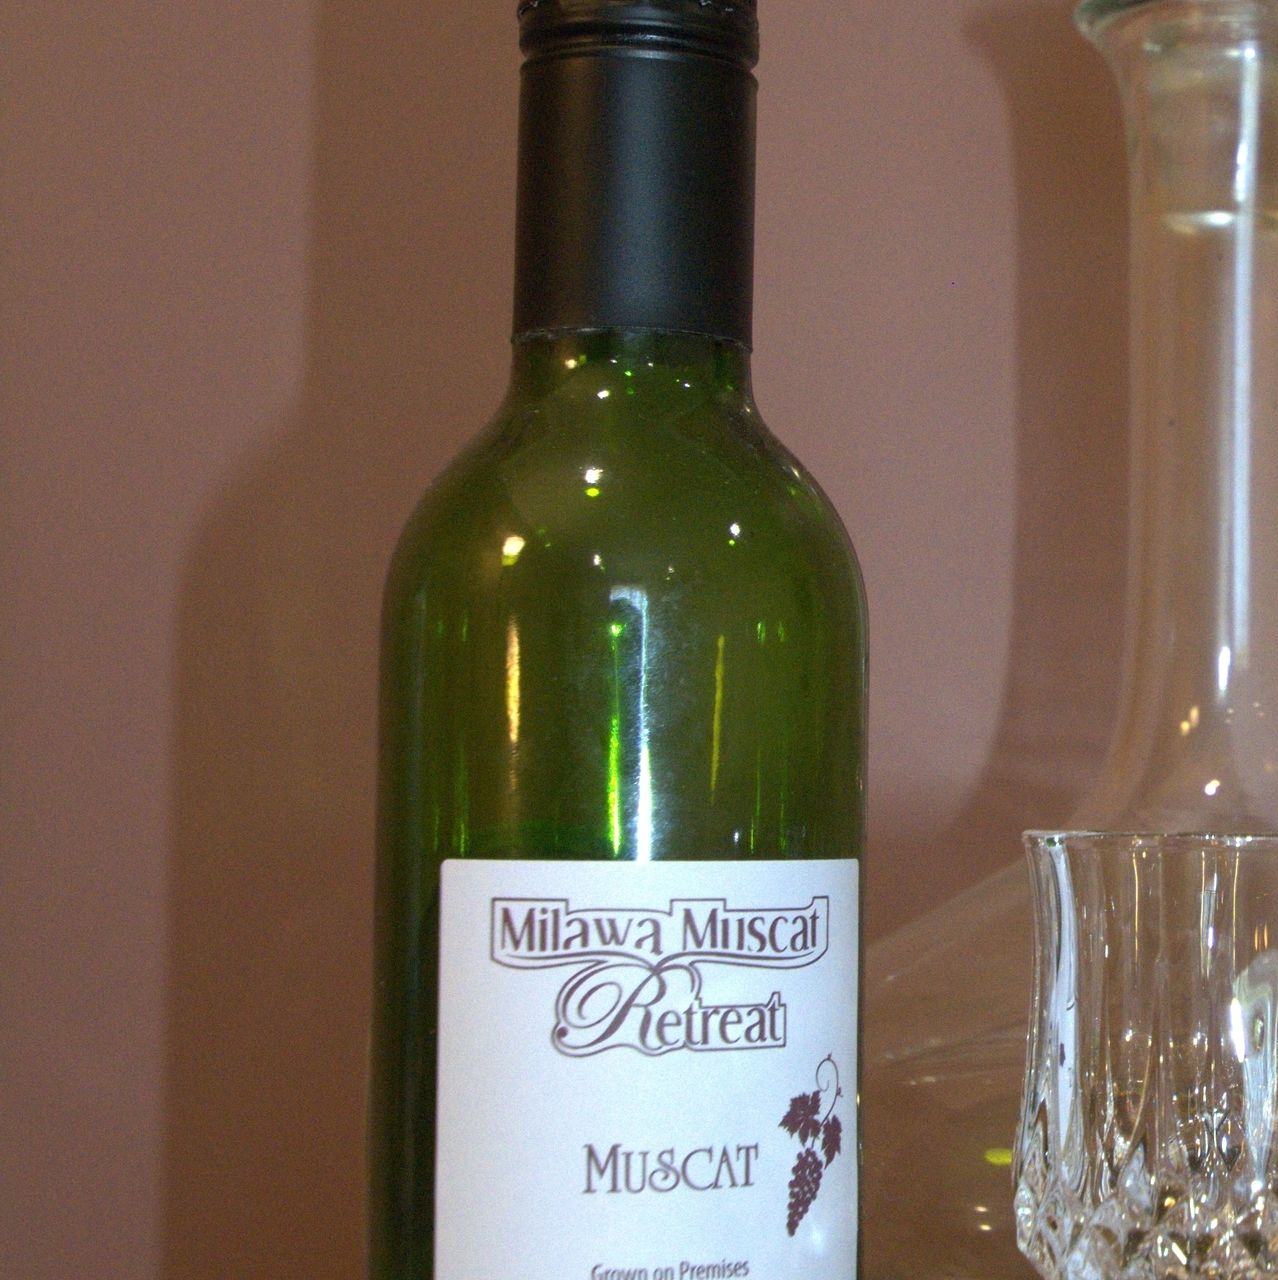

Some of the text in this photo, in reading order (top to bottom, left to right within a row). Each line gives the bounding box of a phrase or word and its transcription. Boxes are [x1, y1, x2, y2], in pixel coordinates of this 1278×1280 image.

[500, 906, 820, 955] Milawa Muscat
[555, 963, 783, 1050] Retreat
[582, 1142, 759, 1195] MUSCAT
[678, 1259, 750, 1280] Premises
